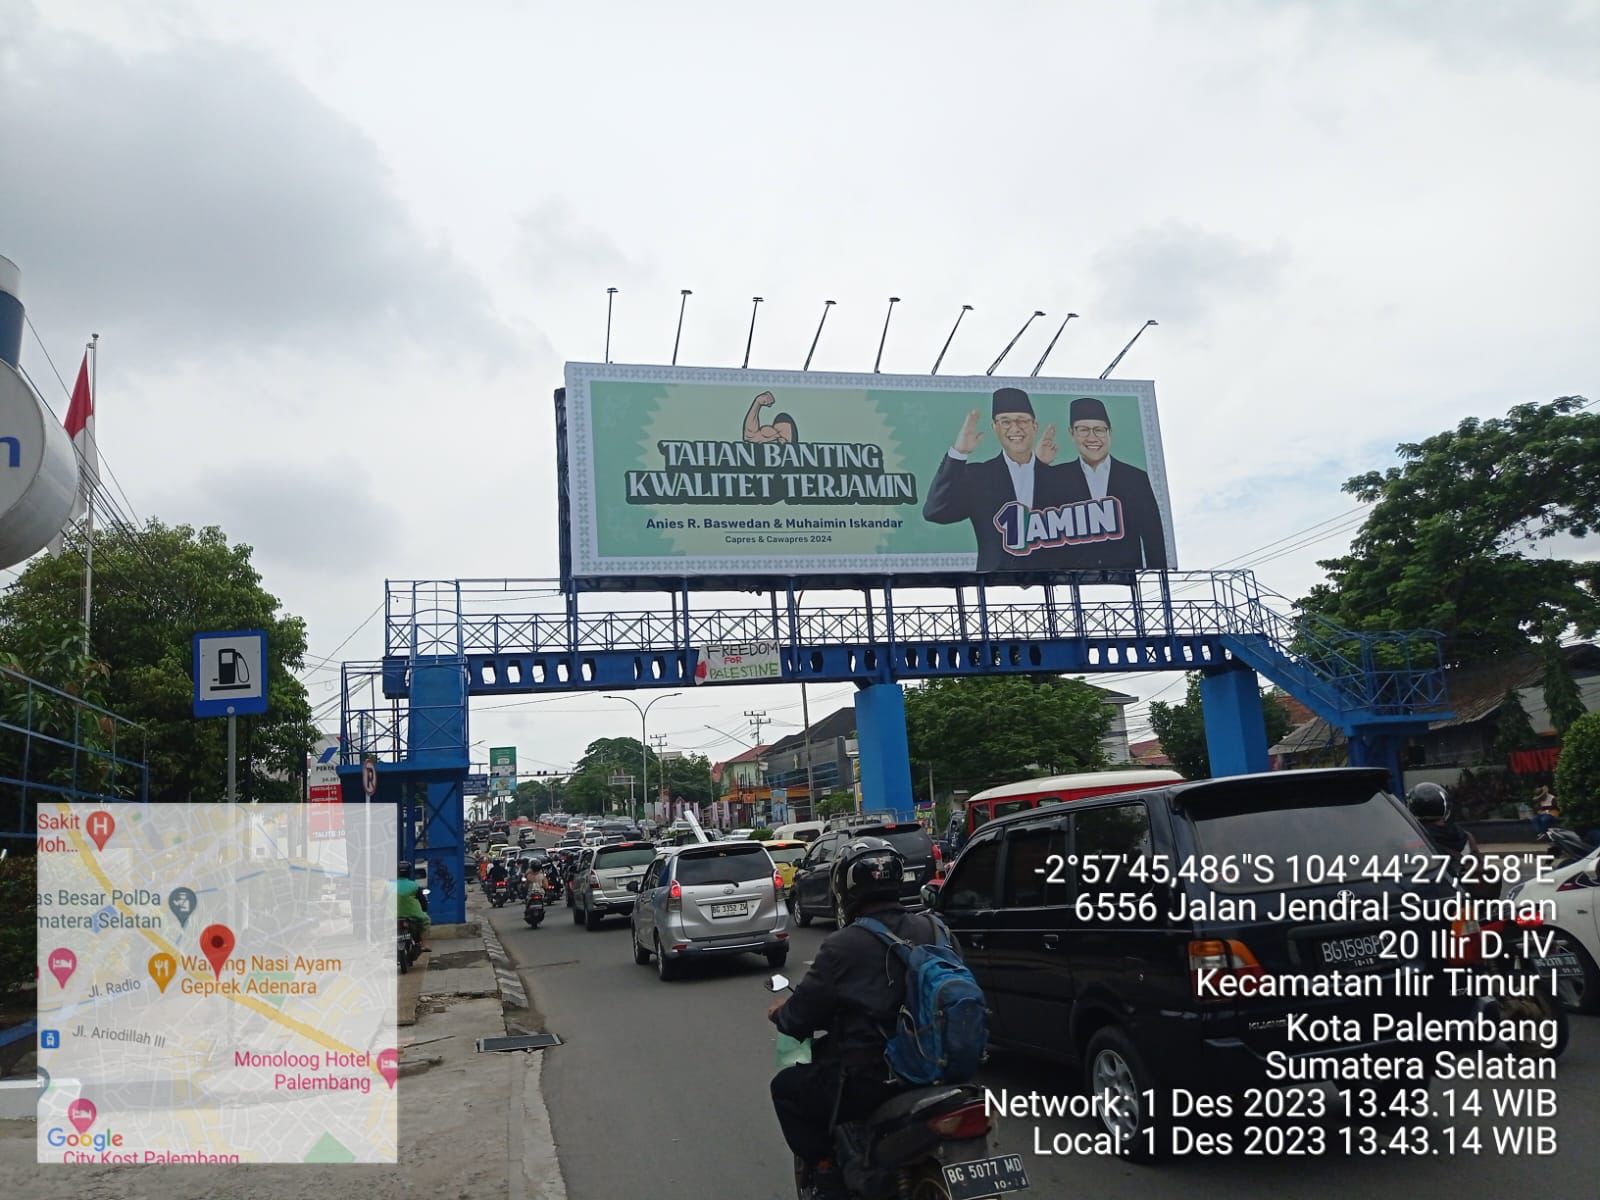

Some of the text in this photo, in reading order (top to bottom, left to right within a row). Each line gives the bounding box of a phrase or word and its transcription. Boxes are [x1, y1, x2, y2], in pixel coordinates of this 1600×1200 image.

[661, 442, 881, 469] TAHAN BANTING
[629, 472, 914, 498] KWALITET TERJAMIN
[646, 518, 904, 529] Anies R. Baswedan & Muhaimin Iskandar
[725, 535, 832, 545] Capres & Cawapres 2024
[707, 641, 778, 659] FREEDOM
[724, 656, 742, 665] FOR
[709, 662, 778, 680] PALESTINE
[968, 1161, 998, 1179] 5077
[1004, 1158, 1022, 1173] MD
